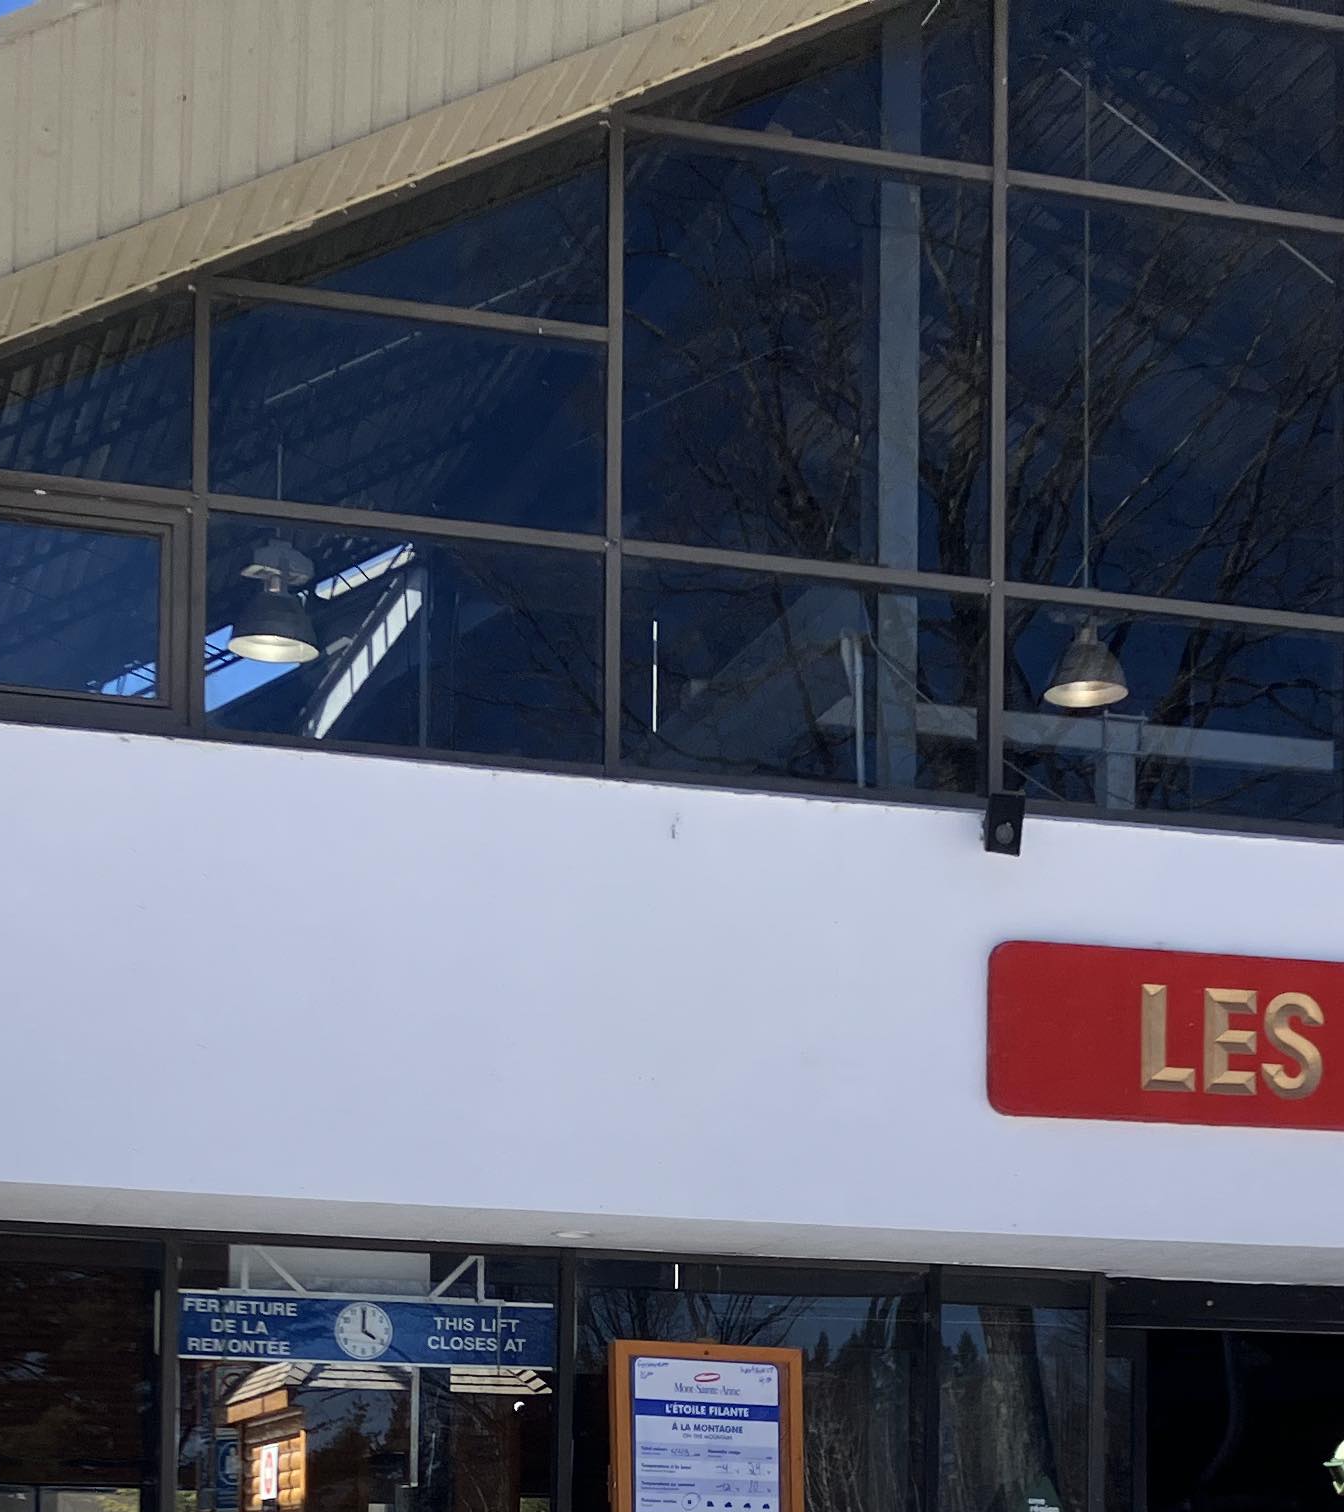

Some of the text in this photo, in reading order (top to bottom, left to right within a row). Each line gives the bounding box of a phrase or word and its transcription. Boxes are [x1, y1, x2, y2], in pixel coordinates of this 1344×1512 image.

[1140, 983, 1325, 1101] LES
[210, 1318, 269, 1335] DE LA
[433, 1316, 520, 1333] THIS LIFT
[427, 1335, 526, 1352] CLOSES AT
[665, 1403, 750, 1418] L'ÉTOILE FILANTE
[680, 1423, 691, 1431] LA
[693, 1424, 743, 1434] MONTAGNE
